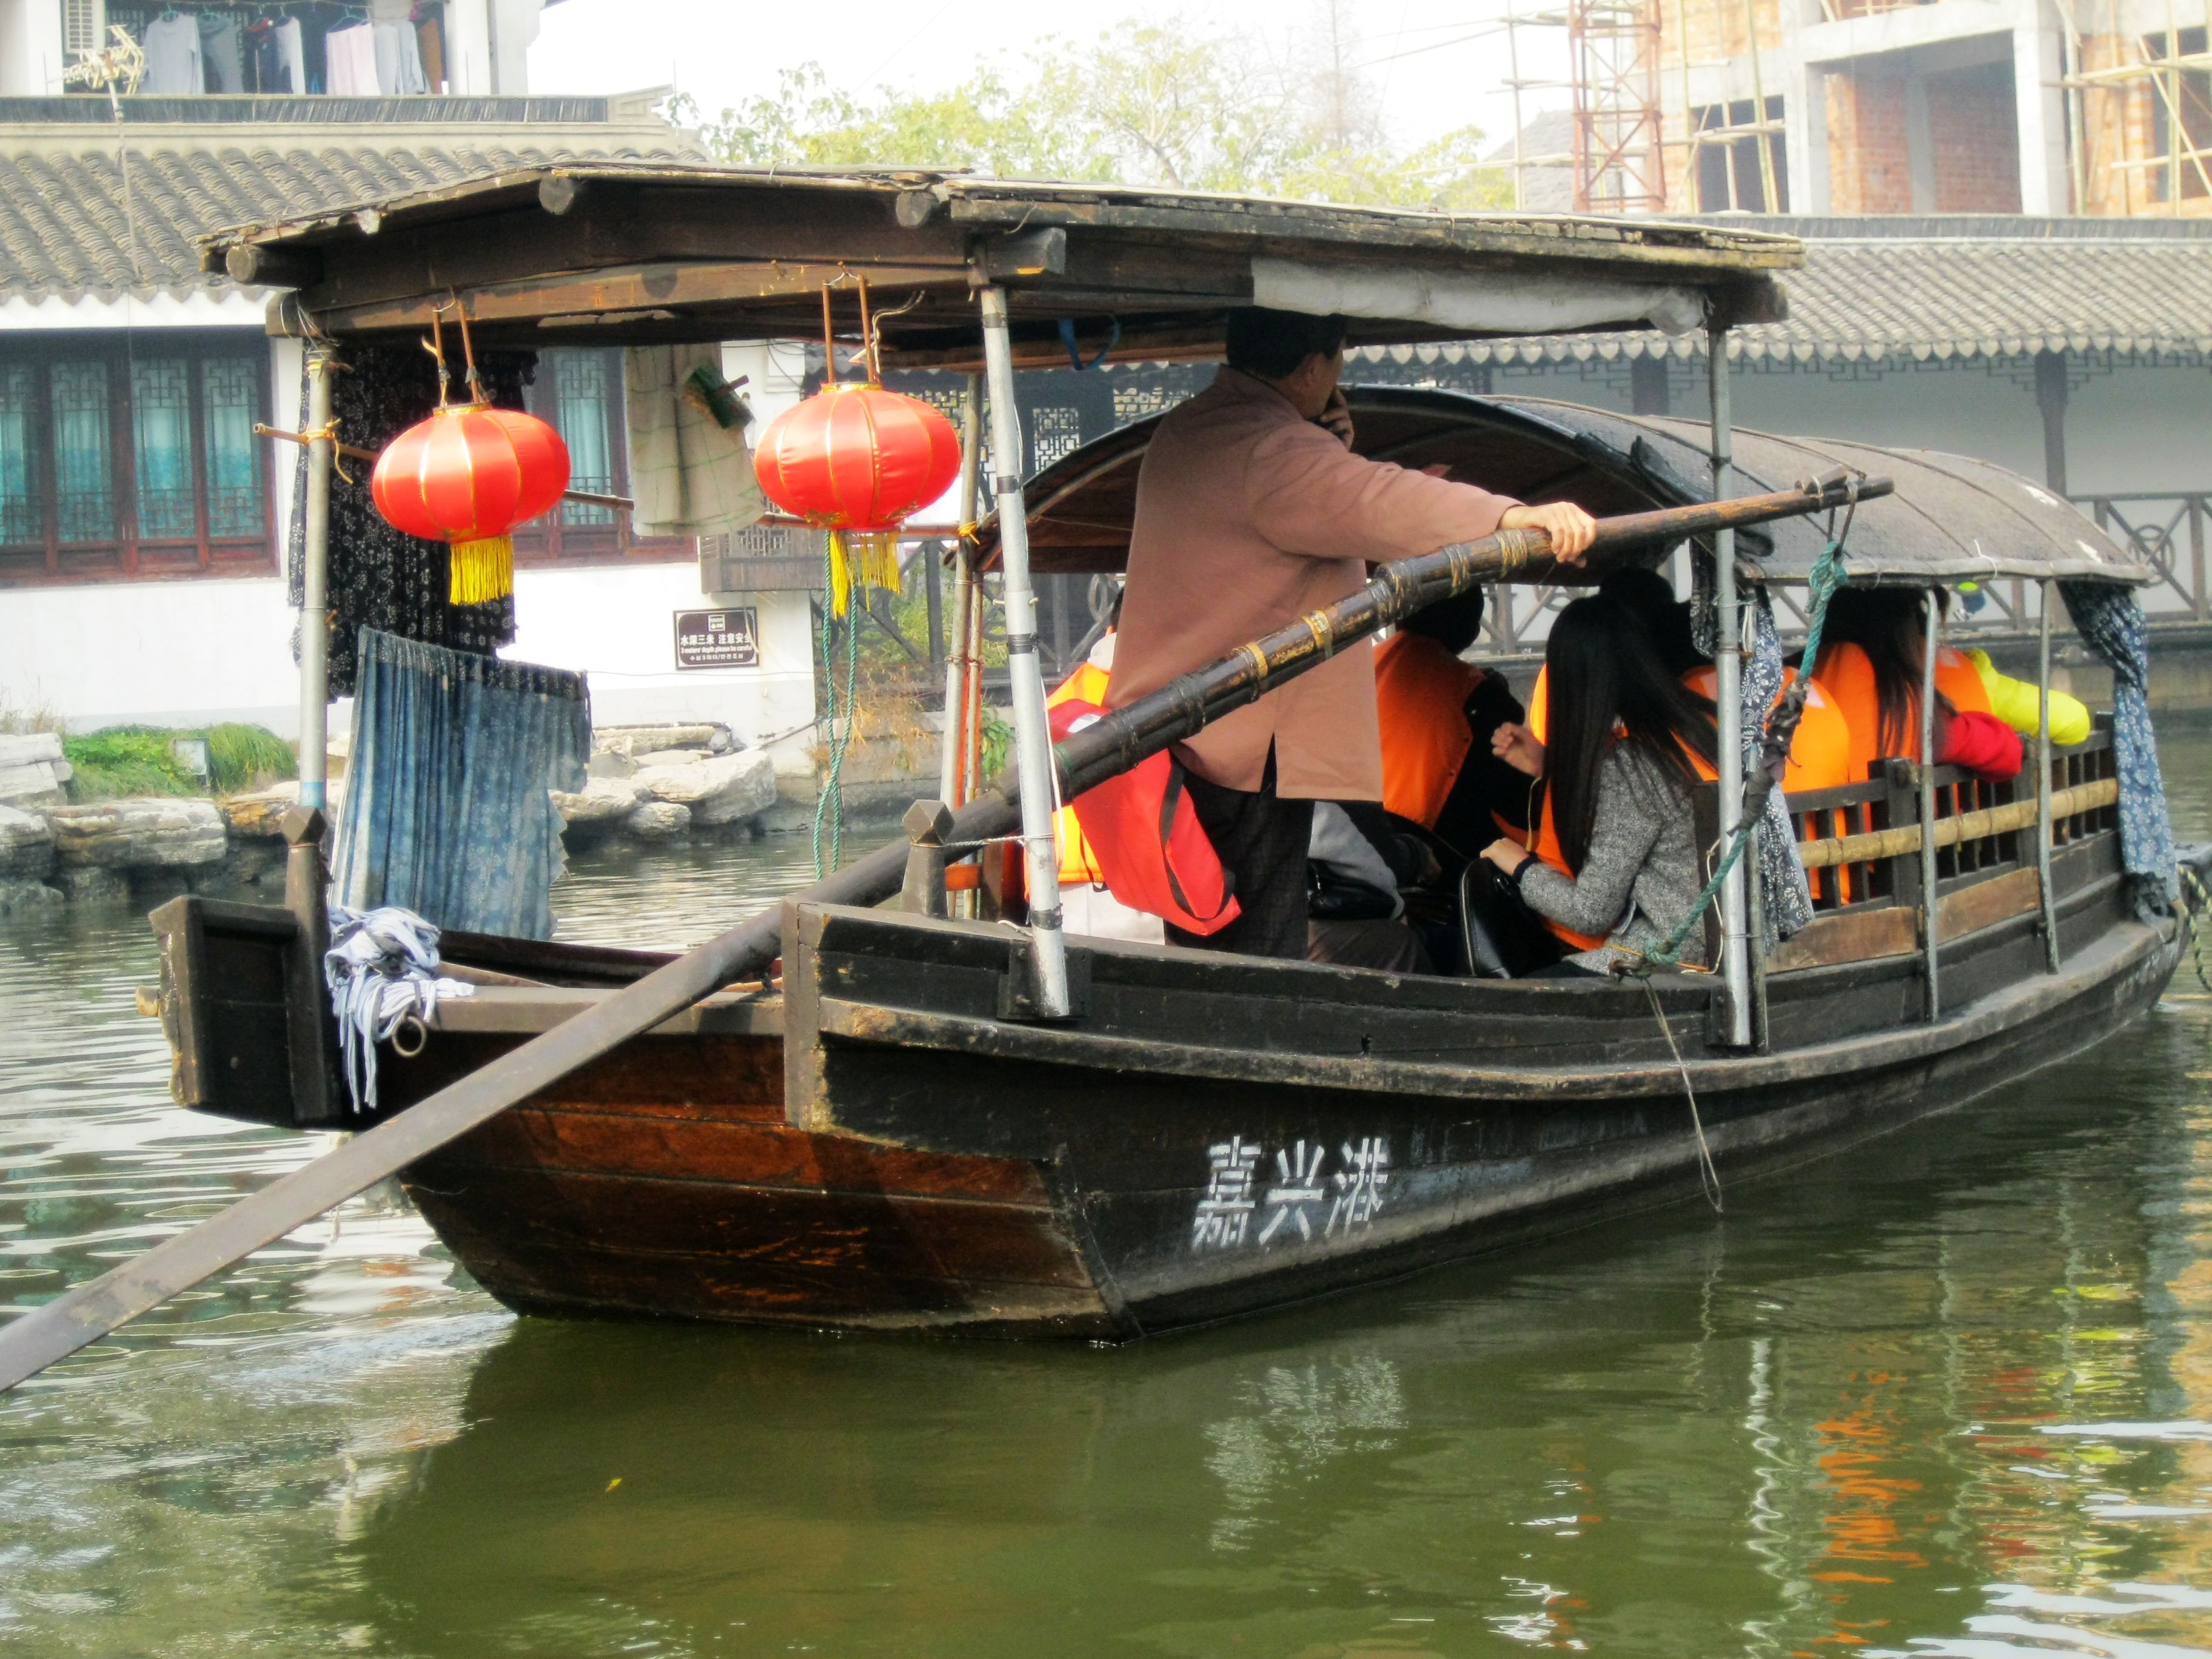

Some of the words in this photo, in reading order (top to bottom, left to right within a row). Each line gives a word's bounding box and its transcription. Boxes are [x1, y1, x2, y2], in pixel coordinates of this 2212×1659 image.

[680, 634, 715, 646] 水深三米
[718, 632, 751, 645] 注意安全
[1192, 1135, 1391, 1251] 嘉兴港
